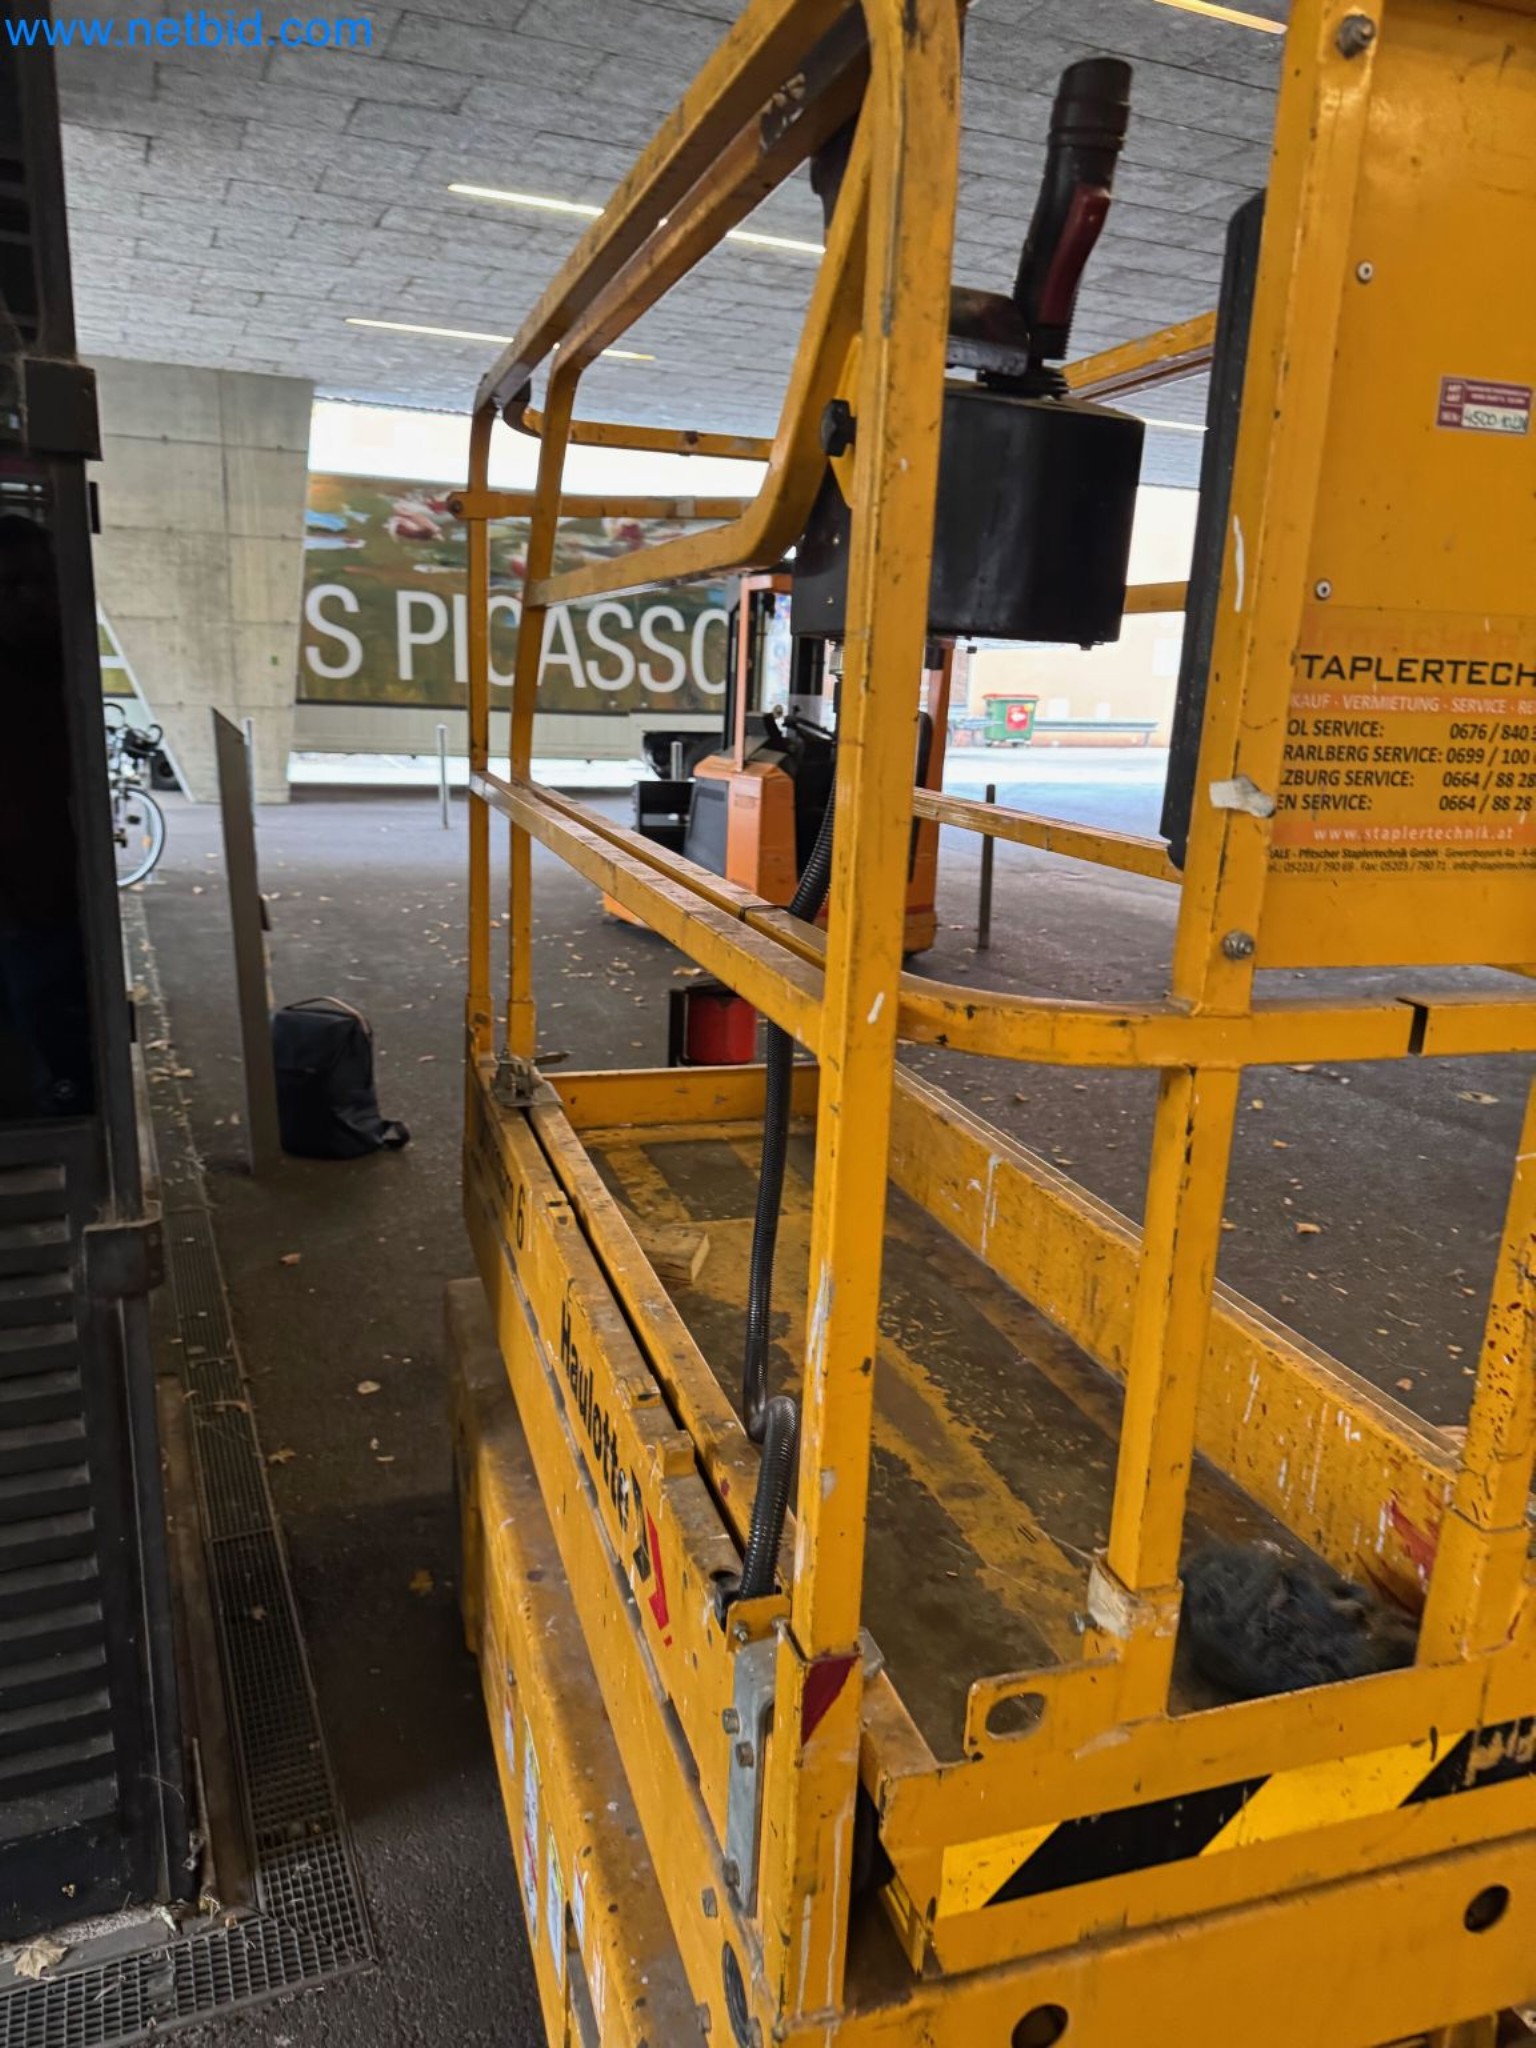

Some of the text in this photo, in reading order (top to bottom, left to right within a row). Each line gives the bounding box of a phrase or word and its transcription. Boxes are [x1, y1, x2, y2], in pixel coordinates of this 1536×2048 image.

[304, 584, 363, 679] S
[1342, 694, 1440, 712] VERMIETUNG
[1451, 699, 1506, 714] SERVICE
[1287, 719, 1309, 737] OL
[1313, 720, 1384, 738] SERVICE:
[1449, 723, 1487, 740] 0676
[1488, 722, 1500, 743] /
[1501, 724, 1528, 741] 840
[1283, 744, 1369, 762] RARLBERG
[1372, 746, 1443, 763] SERVICE:
[1446, 747, 1485, 764] 0699
[1487, 747, 1499, 767] /
[1502, 749, 1530, 765] 100
[1344, 770, 1415, 788] SERVICE:
[1442, 771, 1479, 788] 0664
[1482, 771, 1494, 791] /
[1495, 773, 1515, 788] 88
[1301, 794, 1373, 811] SERVICE:
[1439, 796, 1476, 811] 0664
[1478, 795, 1490, 815] /
[1491, 796, 1510, 812] 88
[1313, 825, 1514, 843] www.staplertechnik.at
[560, 1299, 630, 1533] Haulotte
